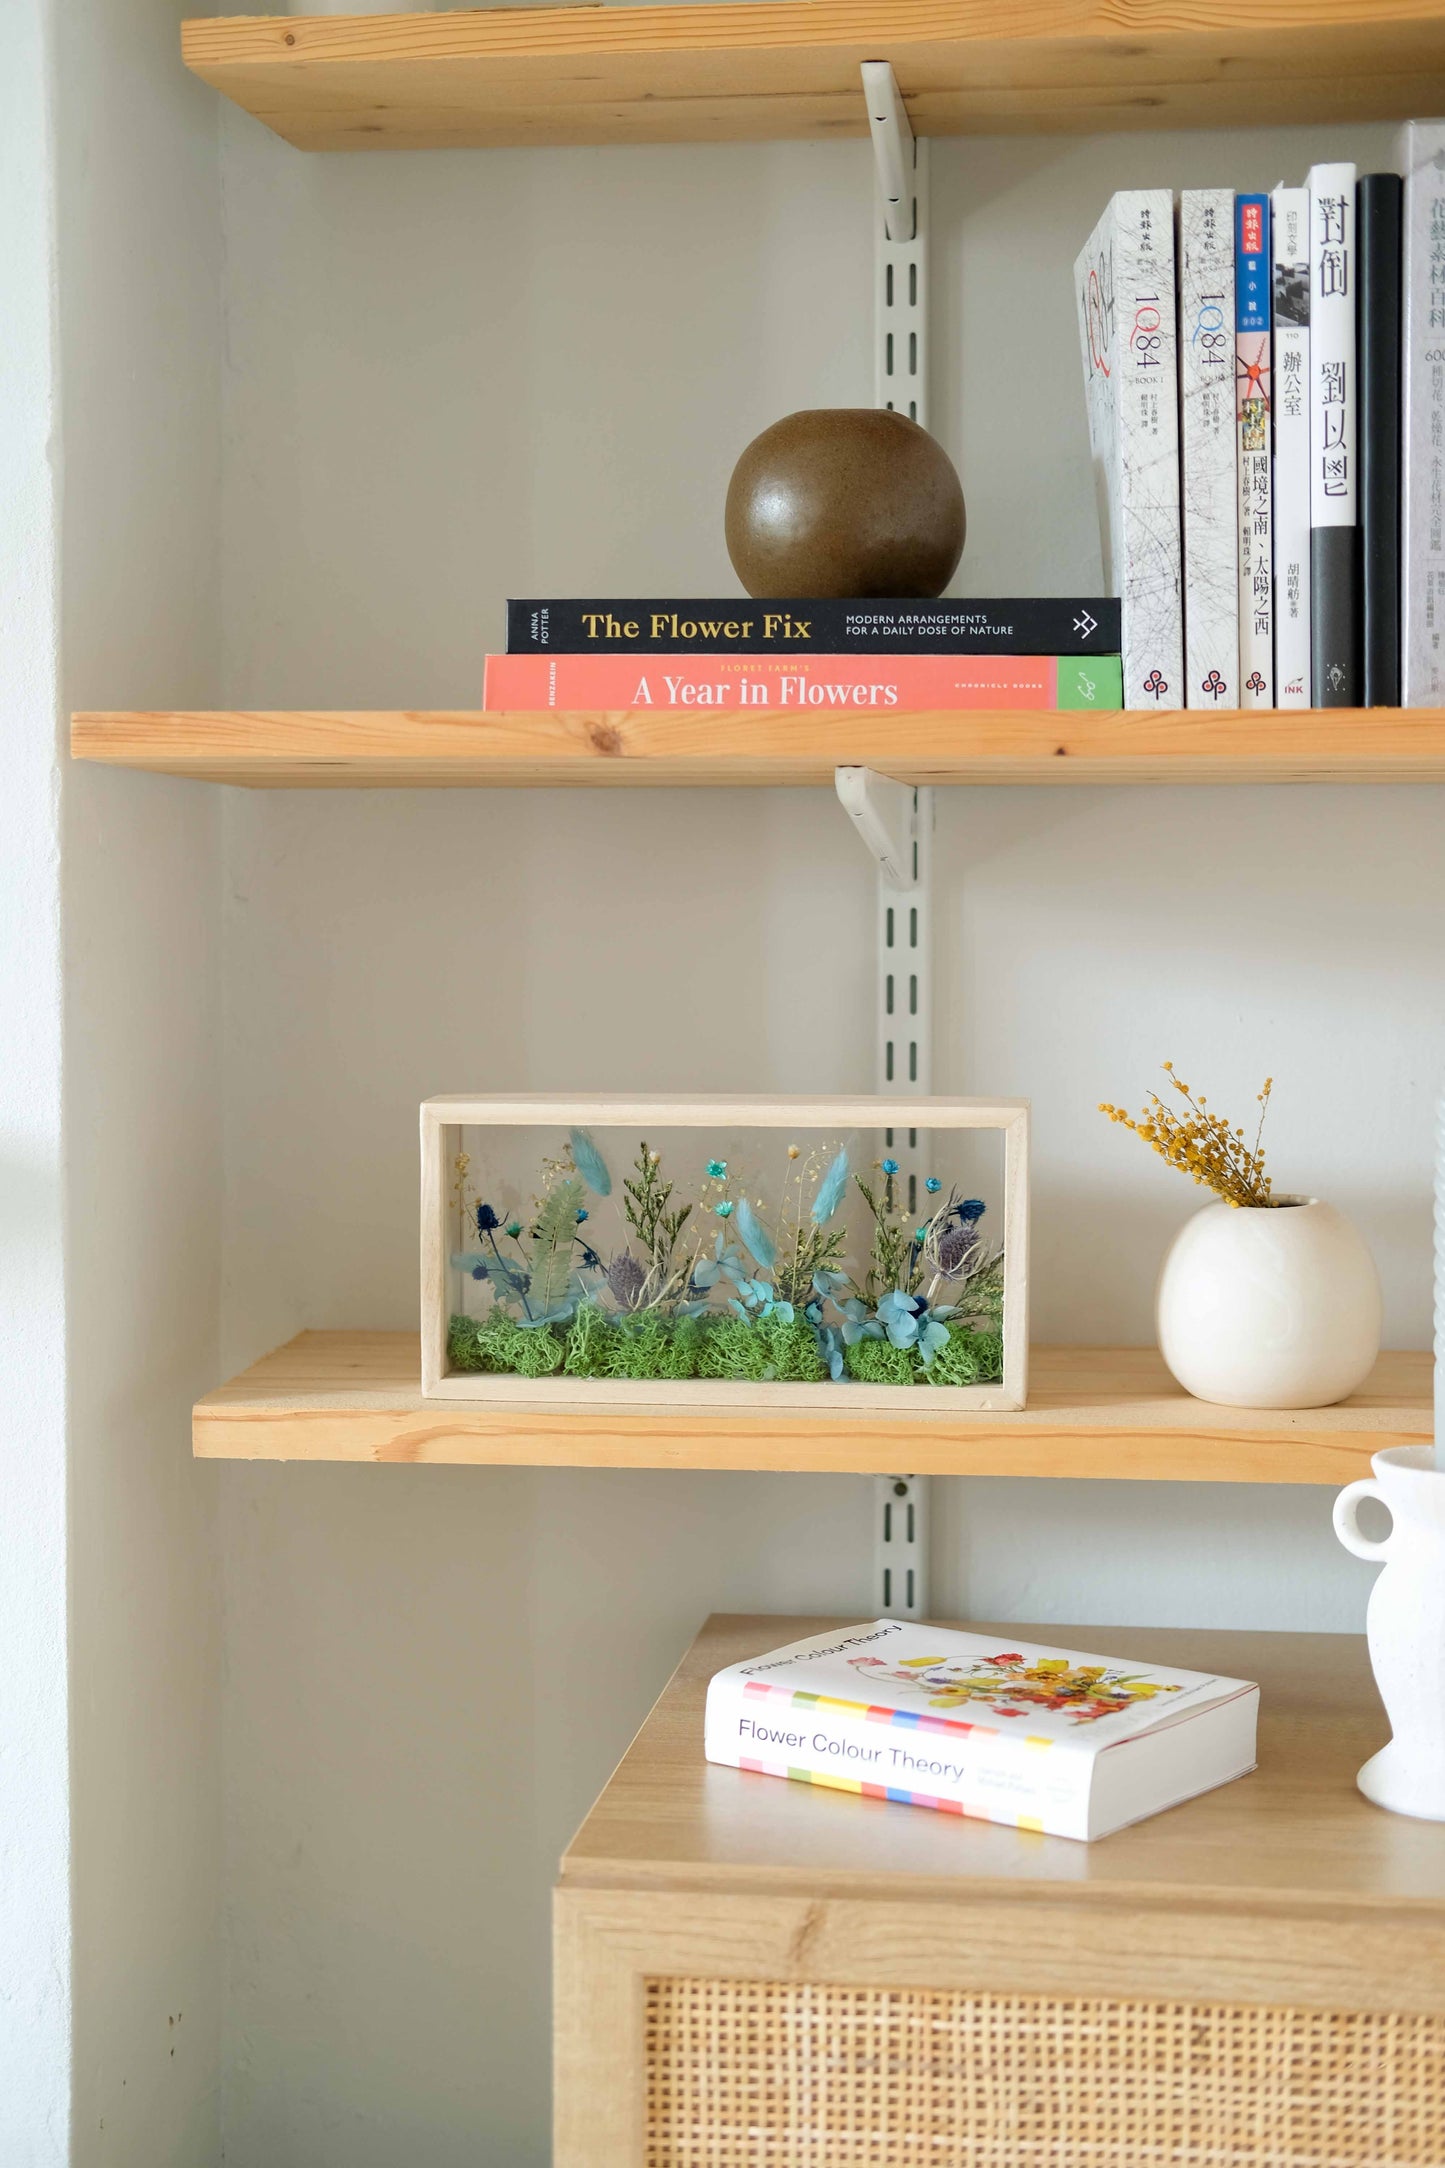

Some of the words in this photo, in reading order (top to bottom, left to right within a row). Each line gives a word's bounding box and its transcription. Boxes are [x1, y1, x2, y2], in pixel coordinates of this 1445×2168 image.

[1245, 207, 1260, 252] 時報出版
[1318, 195, 1349, 298] 對倒
[1130, 292, 1162, 369] 1Q84
[1192, 291, 1226, 367] 1Q84
[1242, 317, 1263, 326] 902
[1283, 351, 1302, 416] 辦公室
[1321, 361, 1348, 497] 劉以鬯
[1252, 455, 1270, 636] 國境之南、太陽之西
[531, 612, 539, 640] ANNA
[541, 608, 549, 644] POTTER
[581, 613, 640, 639] The
[650, 613, 754, 639] Flower
[762, 613, 812, 639] Fix
[846, 615, 894, 624] MODERN
[898, 615, 988, 624] ARRANGEMENTS
[846, 626, 868, 635] FOR
[871, 626, 879, 635] A
[883, 626, 914, 635] DAILY
[918, 626, 947, 635] DOSE
[951, 626, 966, 635] OF
[969, 626, 1014, 635] NATURE
[548, 661, 557, 706] BENZAKEIN
[631, 677, 654, 705] A
[662, 676, 731, 705] Year
[739, 678, 770, 705] in
[779, 676, 898, 706] Flowers
[1284, 685, 1304, 694] INK
[739, 1658, 796, 1676] Flower
[794, 1643, 849, 1661] Colour
[843, 1624, 903, 1647] Theory
[738, 1718, 806, 1748] Flower
[812, 1733, 883, 1764] Colour
[888, 1747, 965, 1784] Theory
